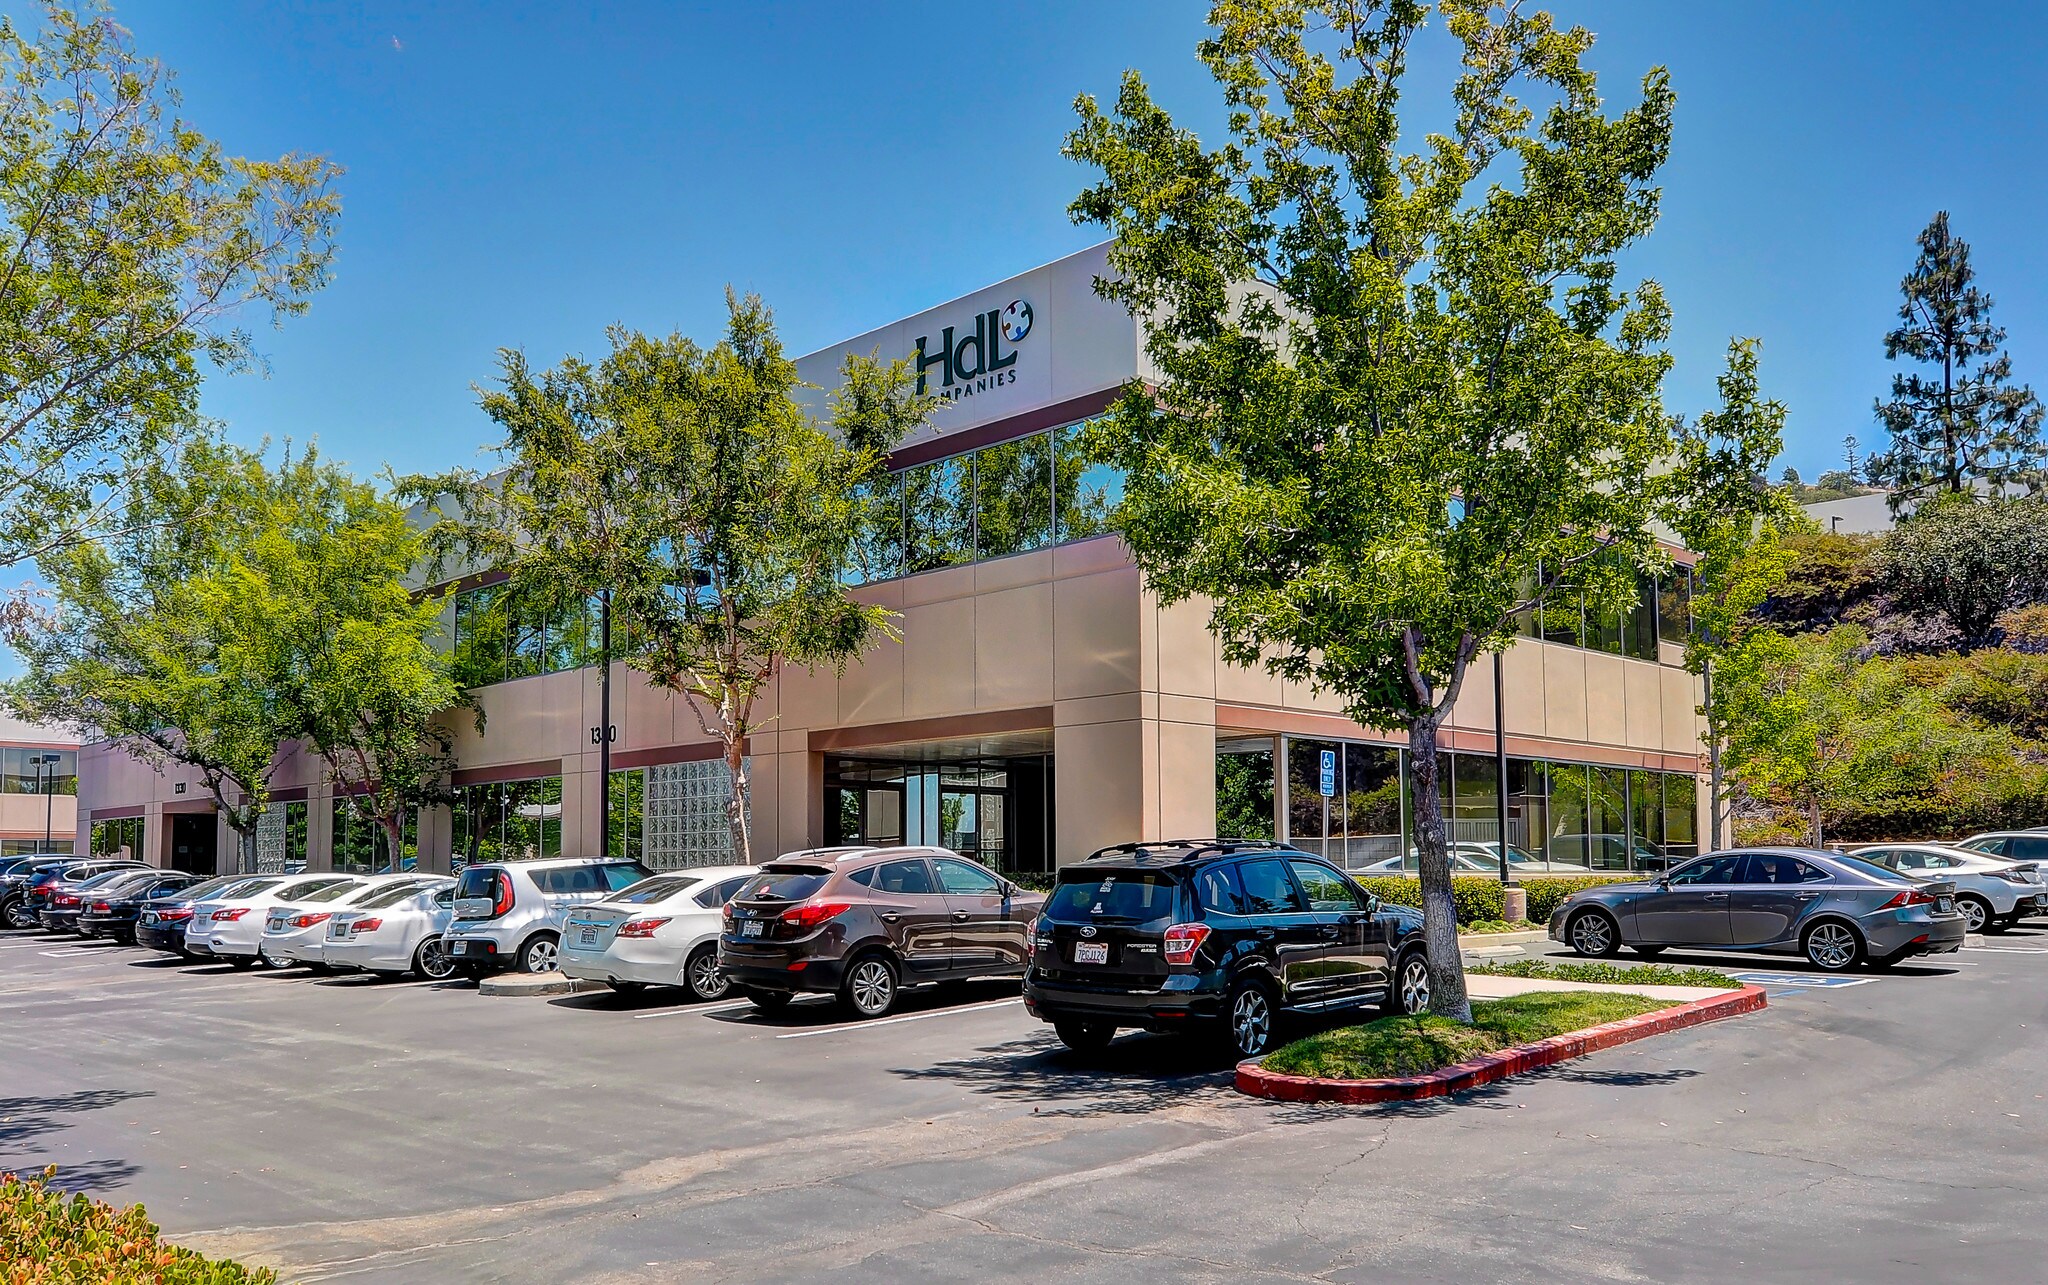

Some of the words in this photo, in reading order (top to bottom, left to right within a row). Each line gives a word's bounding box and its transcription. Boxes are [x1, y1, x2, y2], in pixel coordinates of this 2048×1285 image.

[915, 309, 1018, 396] HdL
[925, 369, 1016, 404] MPANIES
[590, 724, 616, 745] 130
